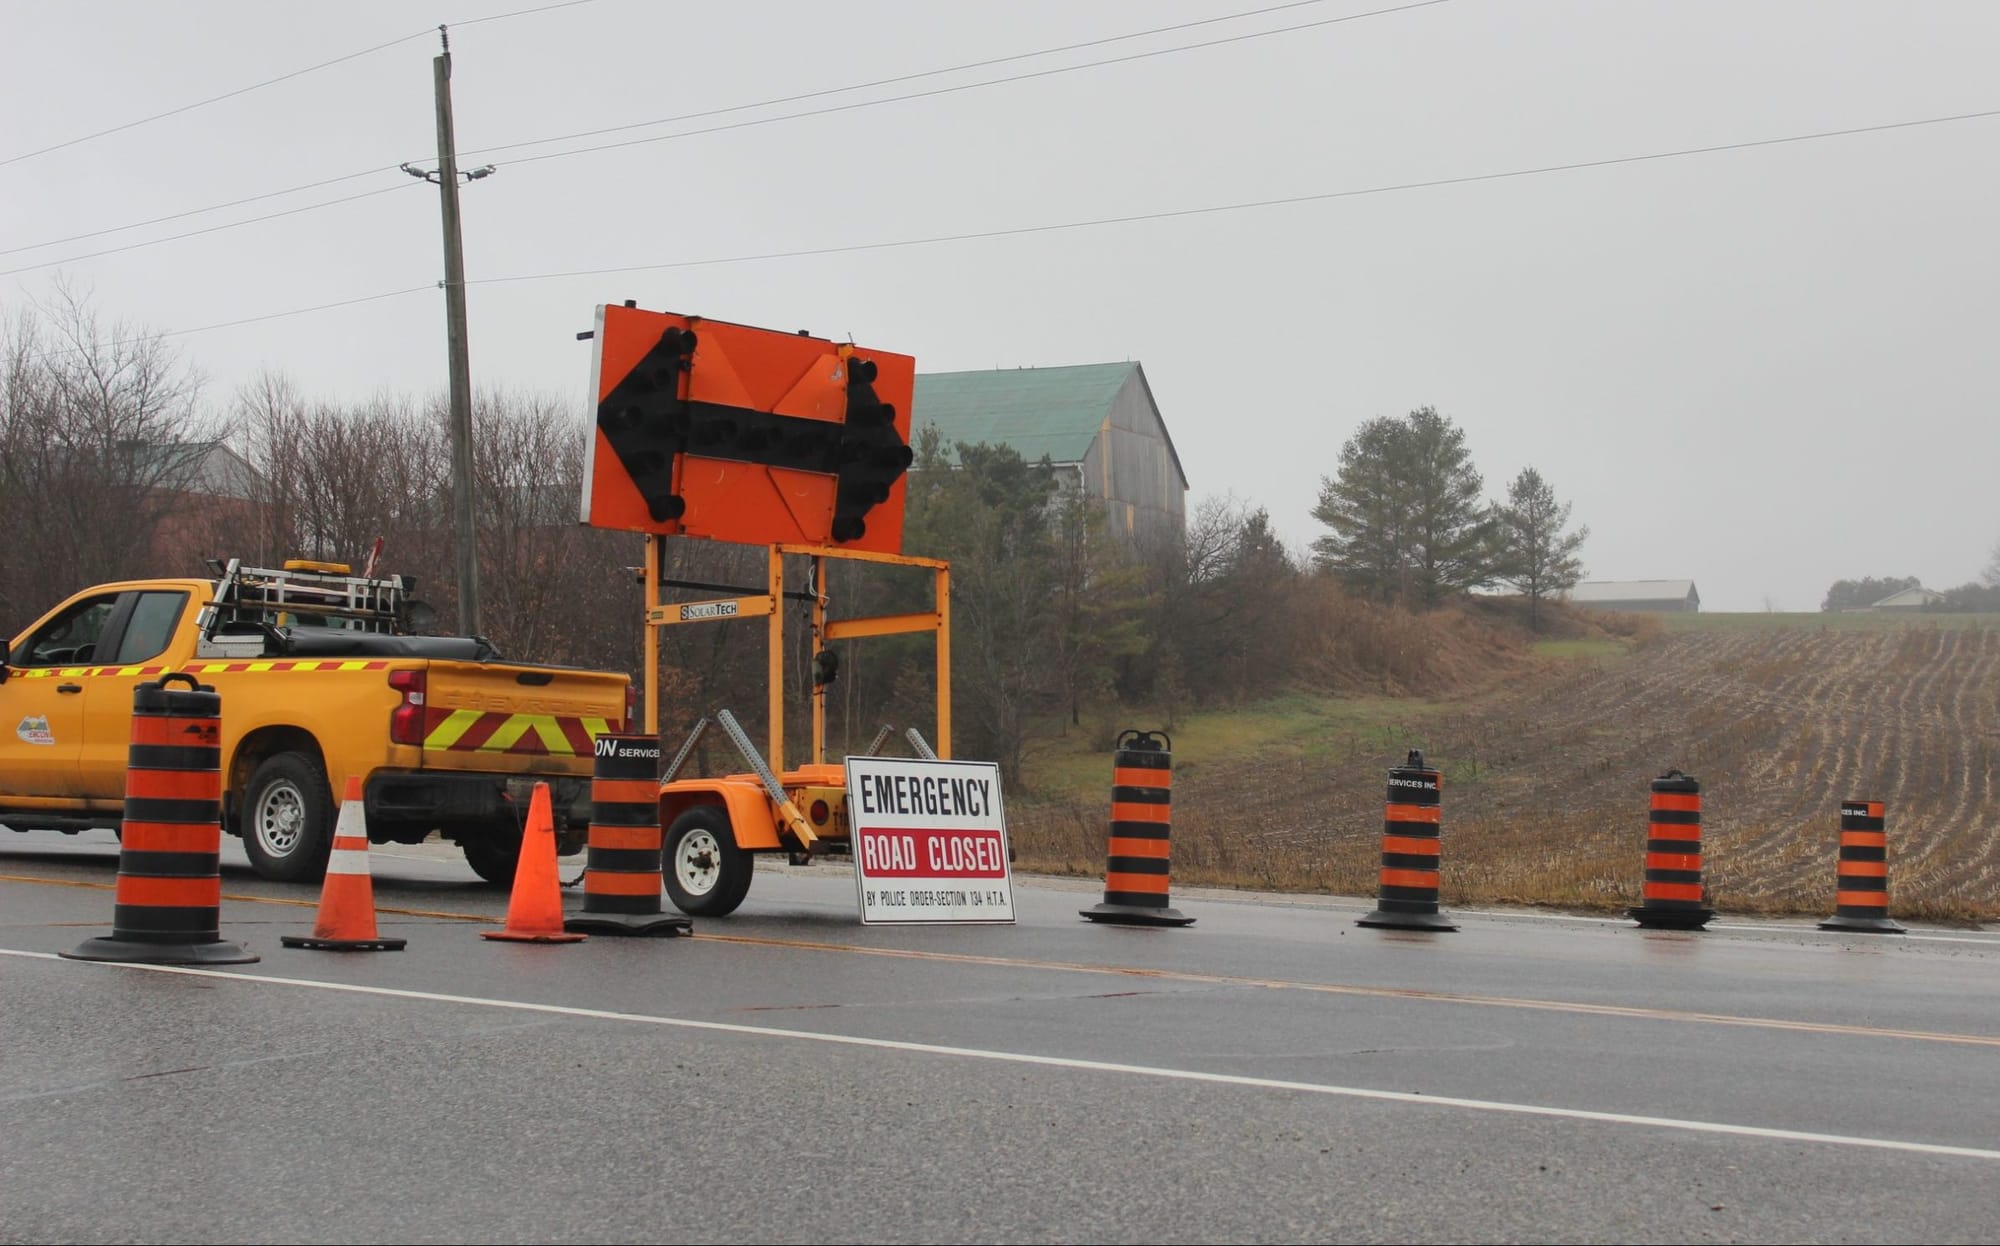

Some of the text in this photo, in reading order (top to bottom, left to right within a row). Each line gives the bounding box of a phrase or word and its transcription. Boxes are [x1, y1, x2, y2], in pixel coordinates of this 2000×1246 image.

[860, 774, 990, 816] EMERGENCY
[863, 835, 1000, 871] ROAD CLOSED
[866, 891, 1007, 906] BY POLICE ORDER-SECTION 134 H.T.A.
